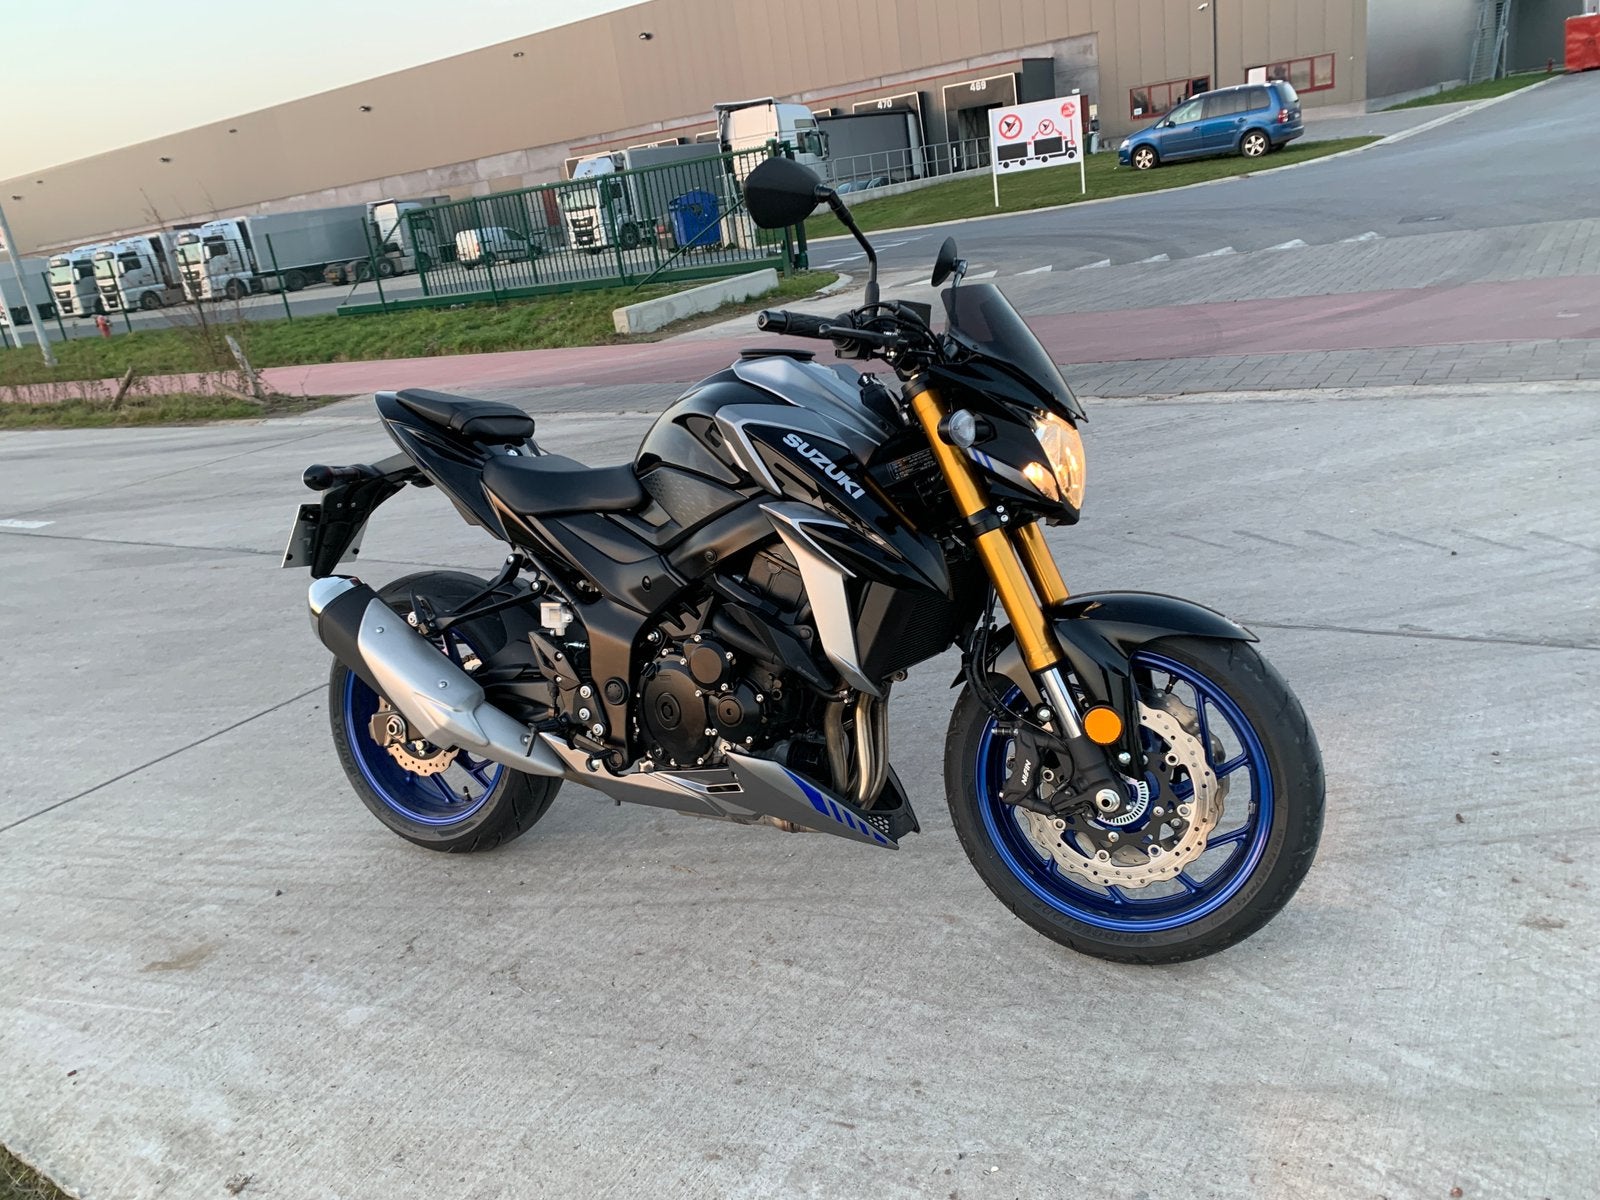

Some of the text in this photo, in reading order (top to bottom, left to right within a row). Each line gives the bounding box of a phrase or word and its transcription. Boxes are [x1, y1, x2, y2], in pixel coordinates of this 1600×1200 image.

[969, 80, 987, 92] 469
[877, 98, 893, 110] 470
[782, 433, 866, 500] SUZUKI
